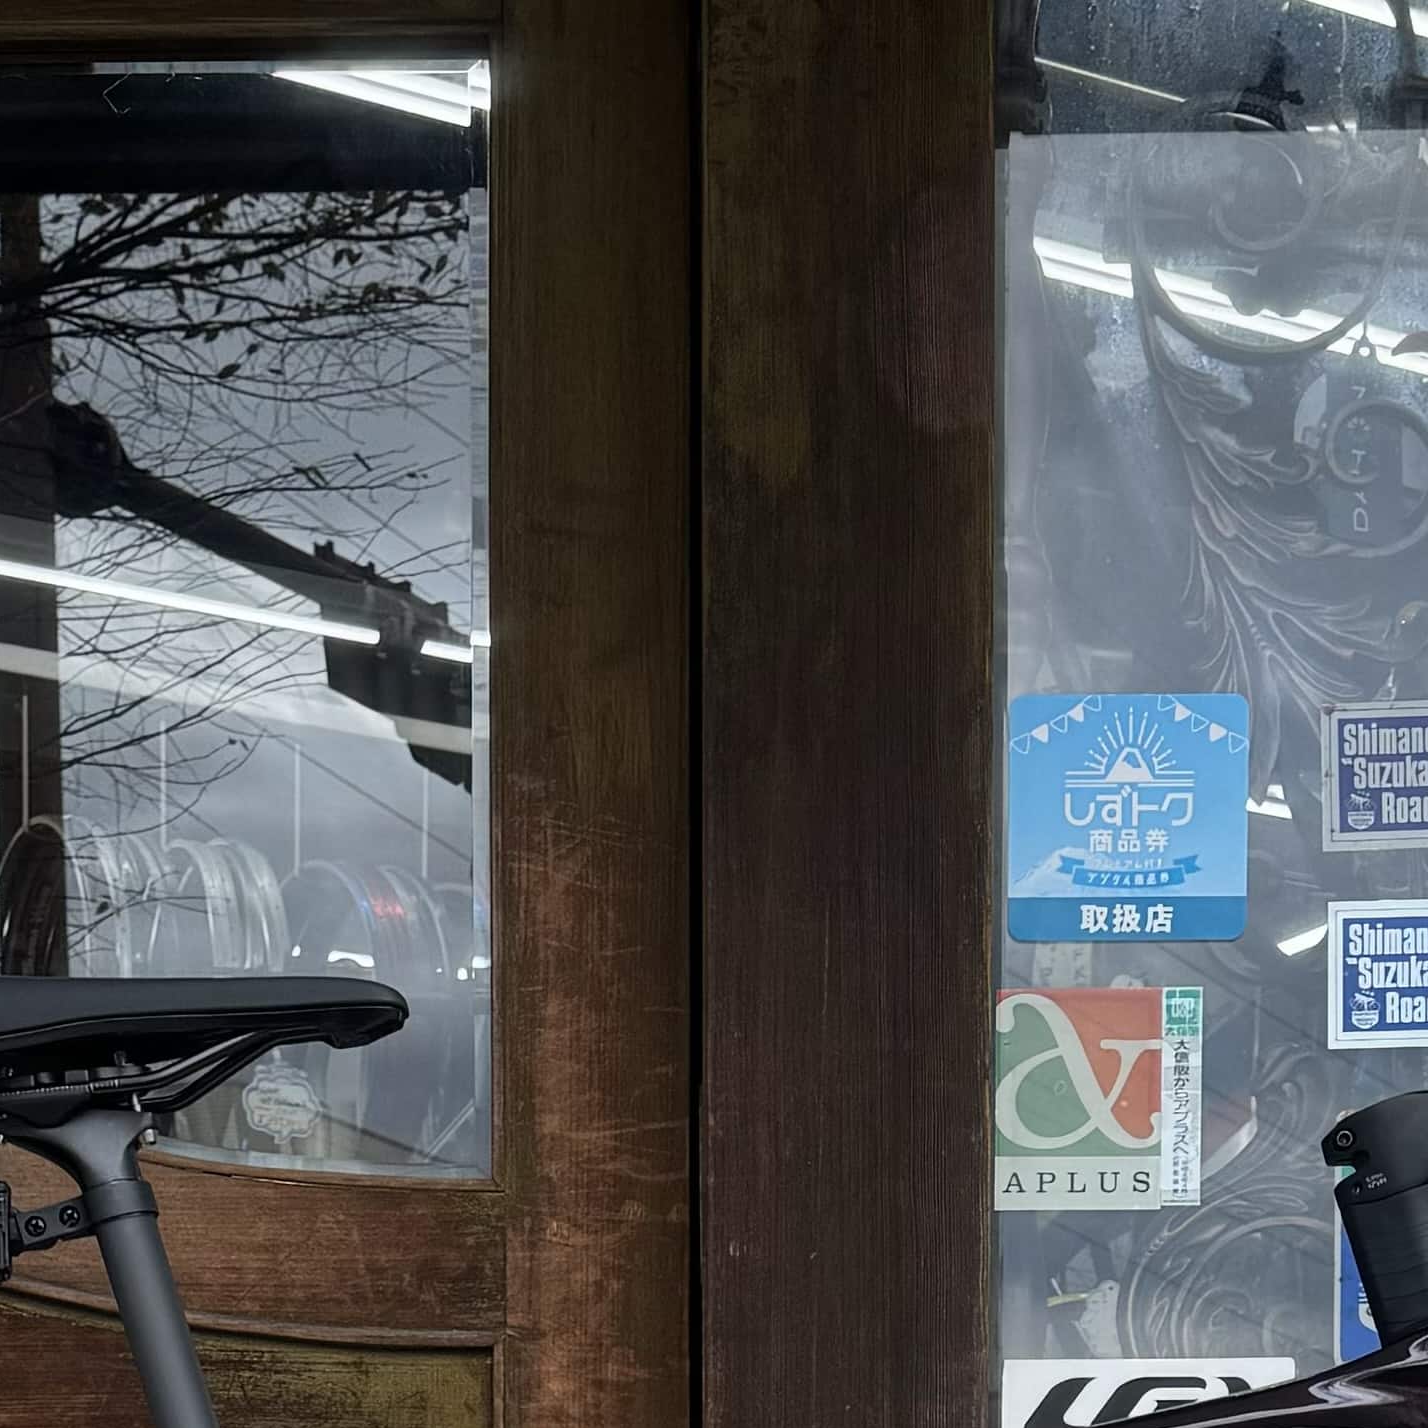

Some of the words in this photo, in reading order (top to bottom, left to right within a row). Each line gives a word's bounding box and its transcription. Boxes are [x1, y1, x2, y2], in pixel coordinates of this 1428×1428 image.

[1064, 785, 1194, 826] しずトク
[1089, 829, 1169, 852] 商品券
[1080, 904, 1174, 933] 取扱店
[1001, 1171, 1151, 1194] APLUS
